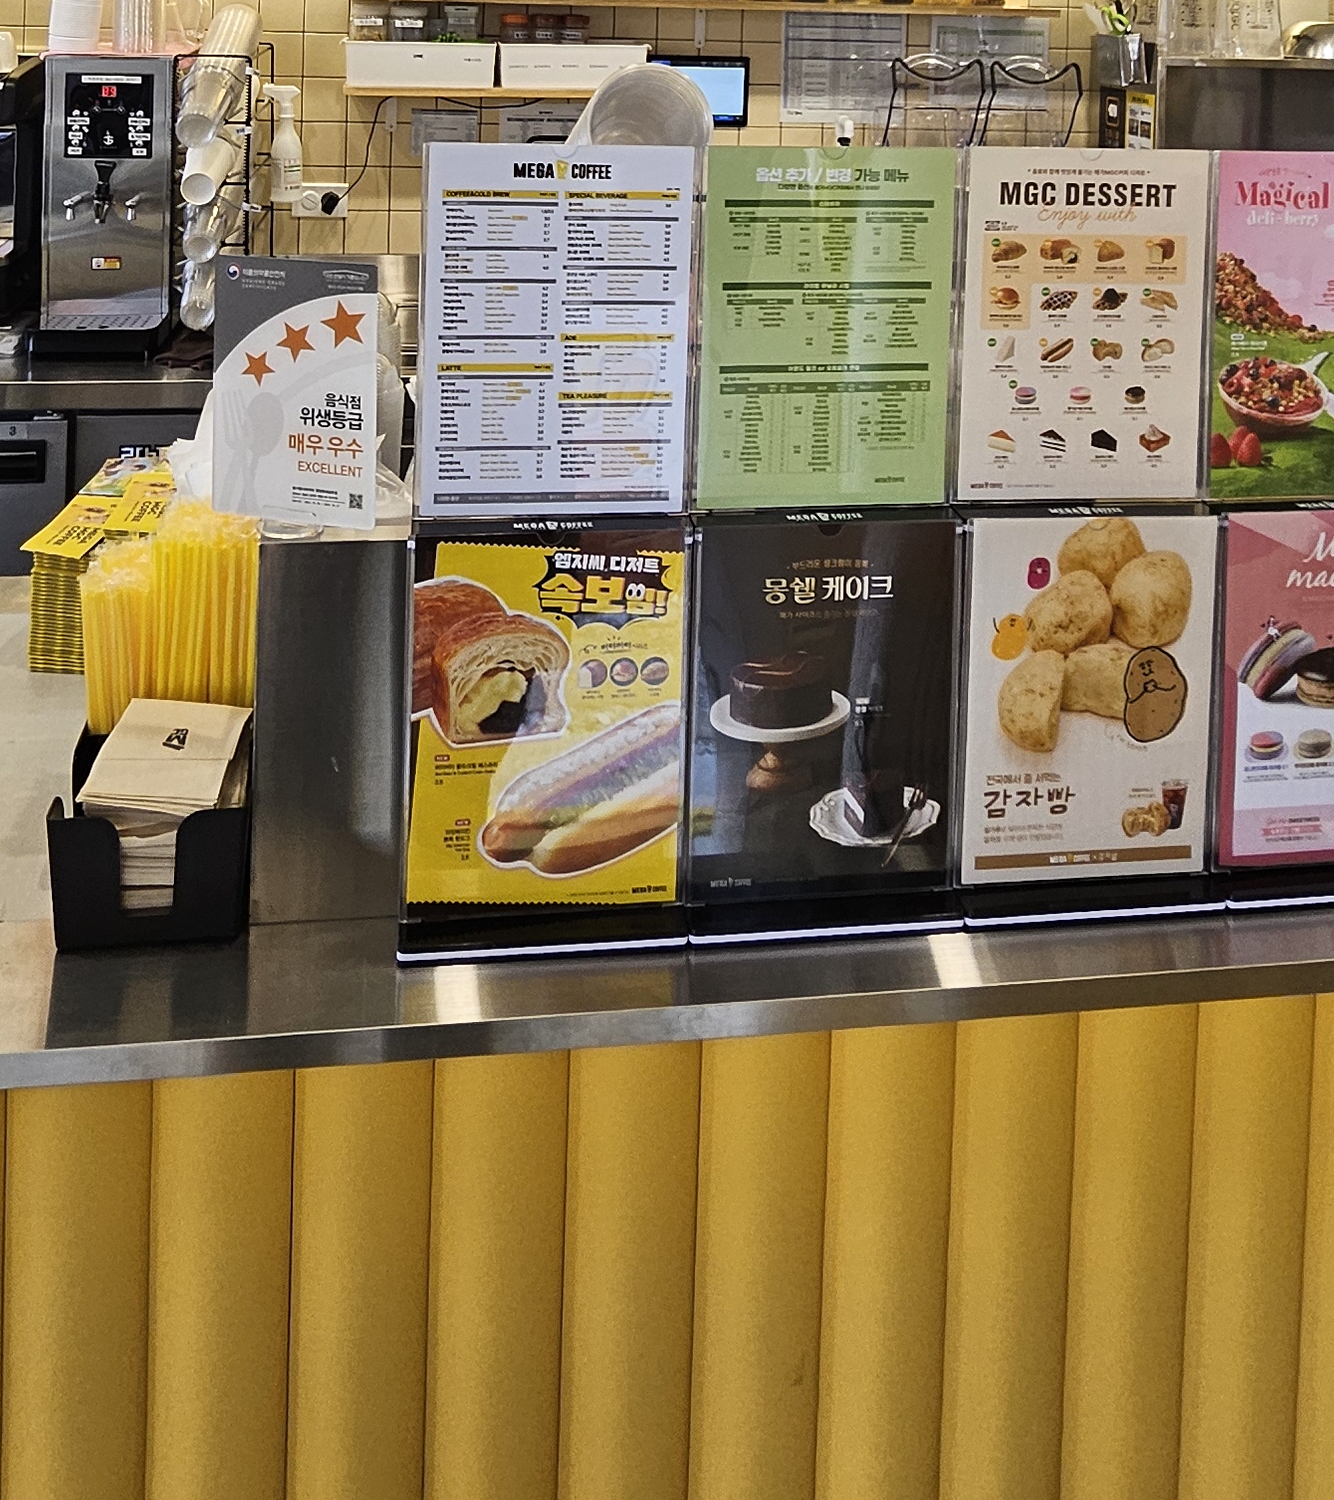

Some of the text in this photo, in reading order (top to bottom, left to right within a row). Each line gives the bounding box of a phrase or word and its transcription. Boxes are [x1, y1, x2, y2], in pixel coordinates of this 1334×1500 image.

[514, 163, 612, 180] MEGA COFFEE
[756, 168, 909, 182] 옵션 추가 변경 가능 메뉴
[1000, 182, 1177, 207] MGC DESSERT
[1235, 181, 1330, 209] Magical
[1038, 202, 1137, 228] Enjoy with
[324, 393, 361, 409] 음식점
[300, 407, 363, 431] 위생등급
[289, 434, 363, 459] 매우 우수
[298, 461, 363, 478] EXCELLENT
[610, 558, 659, 573] 디저트
[763, 576, 893, 604] 몽쉘 케이크
[984, 786, 1076, 819] 감자빵
